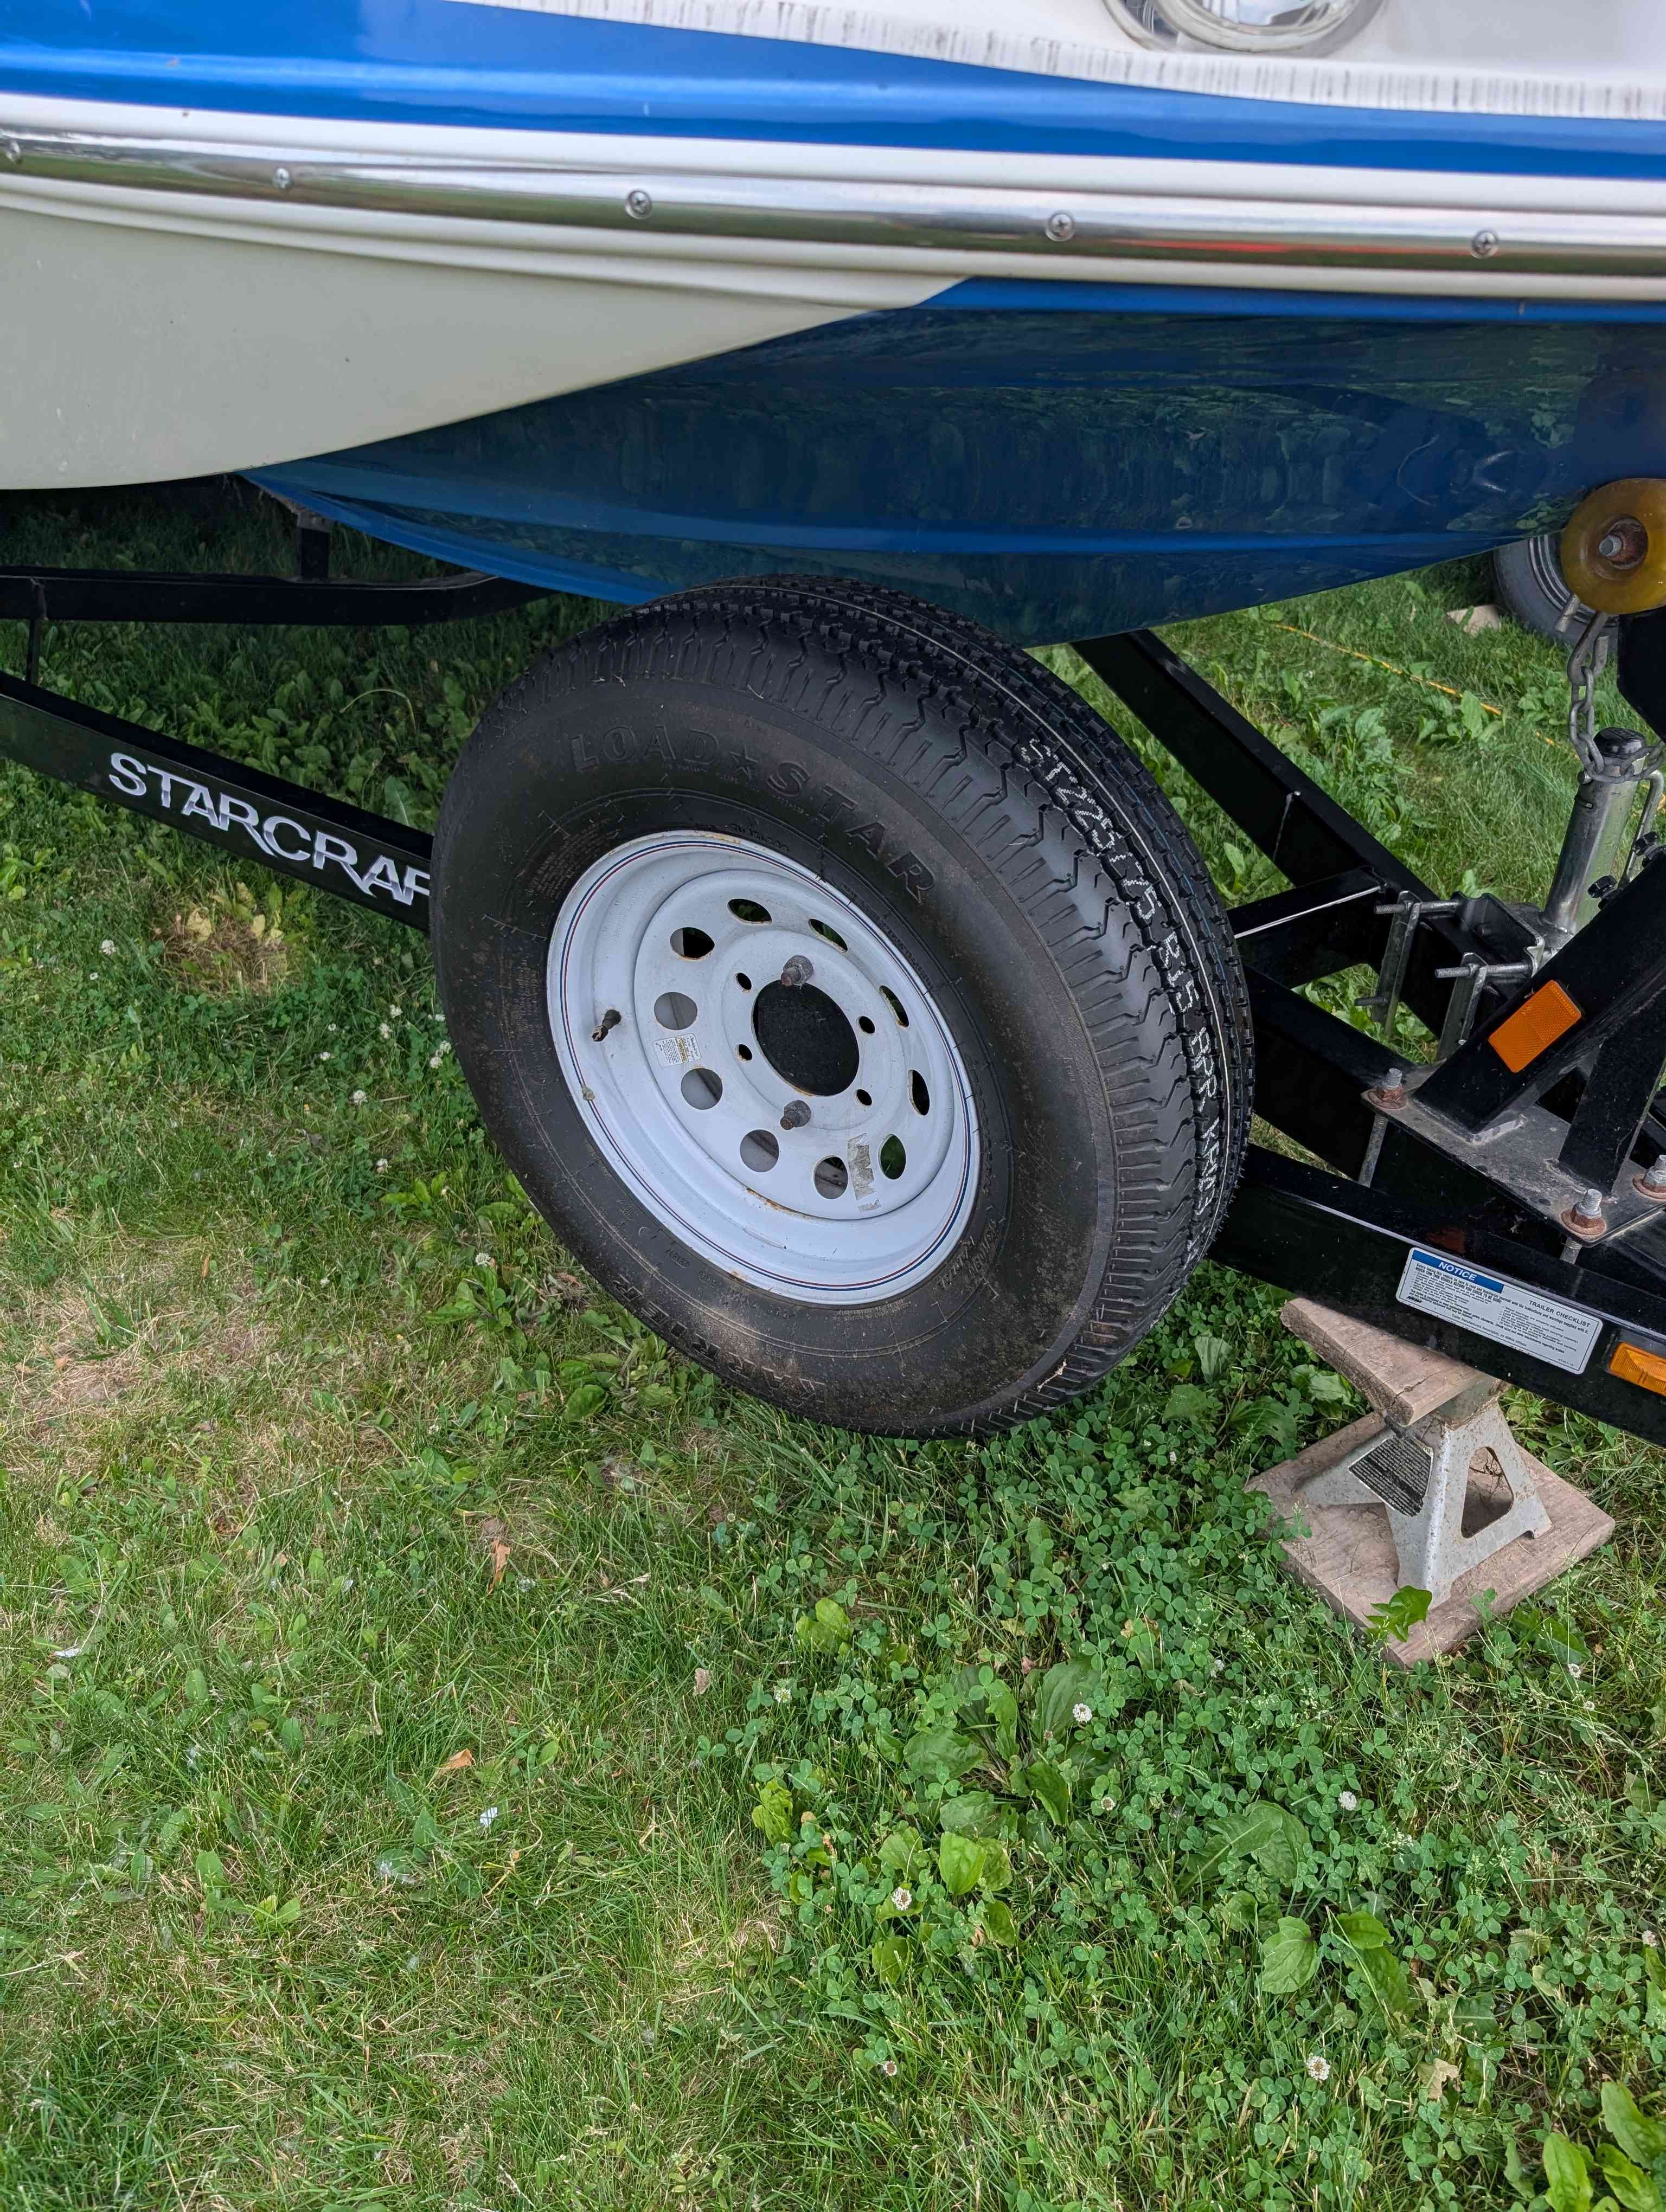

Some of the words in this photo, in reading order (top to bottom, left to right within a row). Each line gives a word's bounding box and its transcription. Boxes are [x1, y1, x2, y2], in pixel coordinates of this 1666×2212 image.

[569, 724, 720, 772] LOAD
[766, 761, 935, 905] STAR
[1438, 1262, 1476, 1281] NOTICE
[1529, 1300, 1554, 1313] TRAILER
[1555, 1310, 1591, 1328] CHECKLIST
